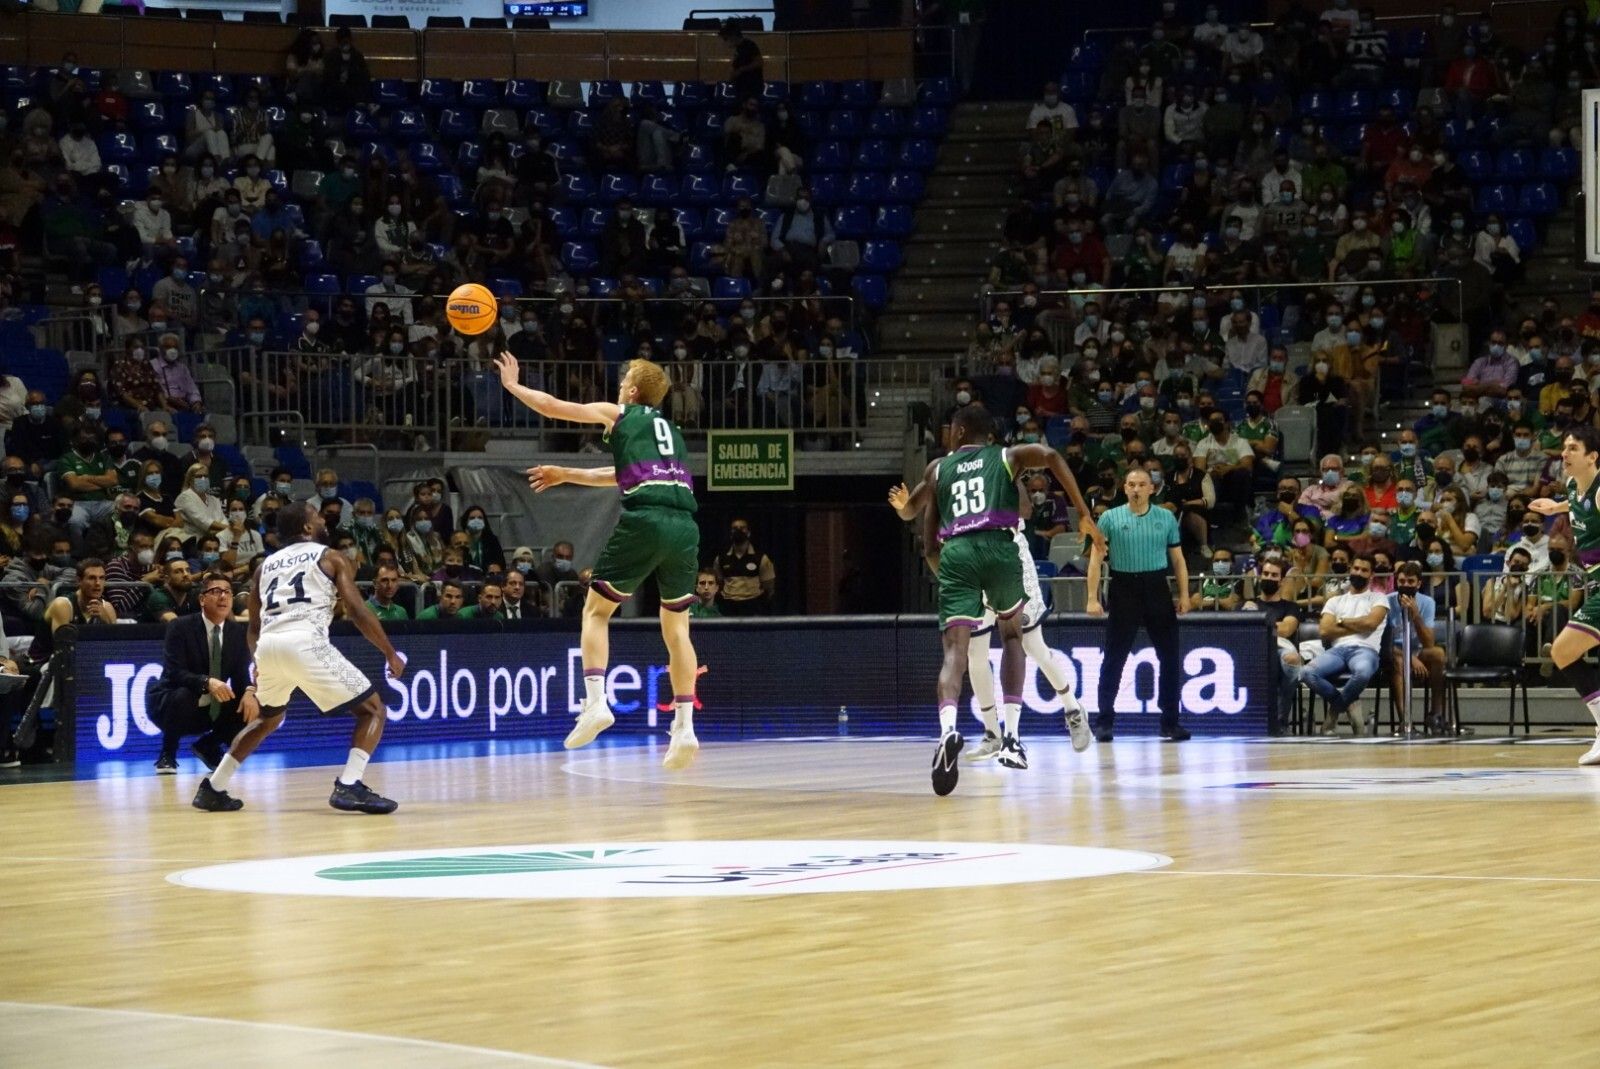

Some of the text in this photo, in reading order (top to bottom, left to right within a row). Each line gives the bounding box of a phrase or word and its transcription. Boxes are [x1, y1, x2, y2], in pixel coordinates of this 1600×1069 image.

[653, 417, 675, 456] 9
[718, 443, 783, 460] SALIDA DE
[713, 462, 787, 480] EMERGENCIA
[951, 476, 986, 518] 33
[264, 571, 312, 617] 11
[384, 649, 477, 721] Solo
[488, 665, 557, 732] por
